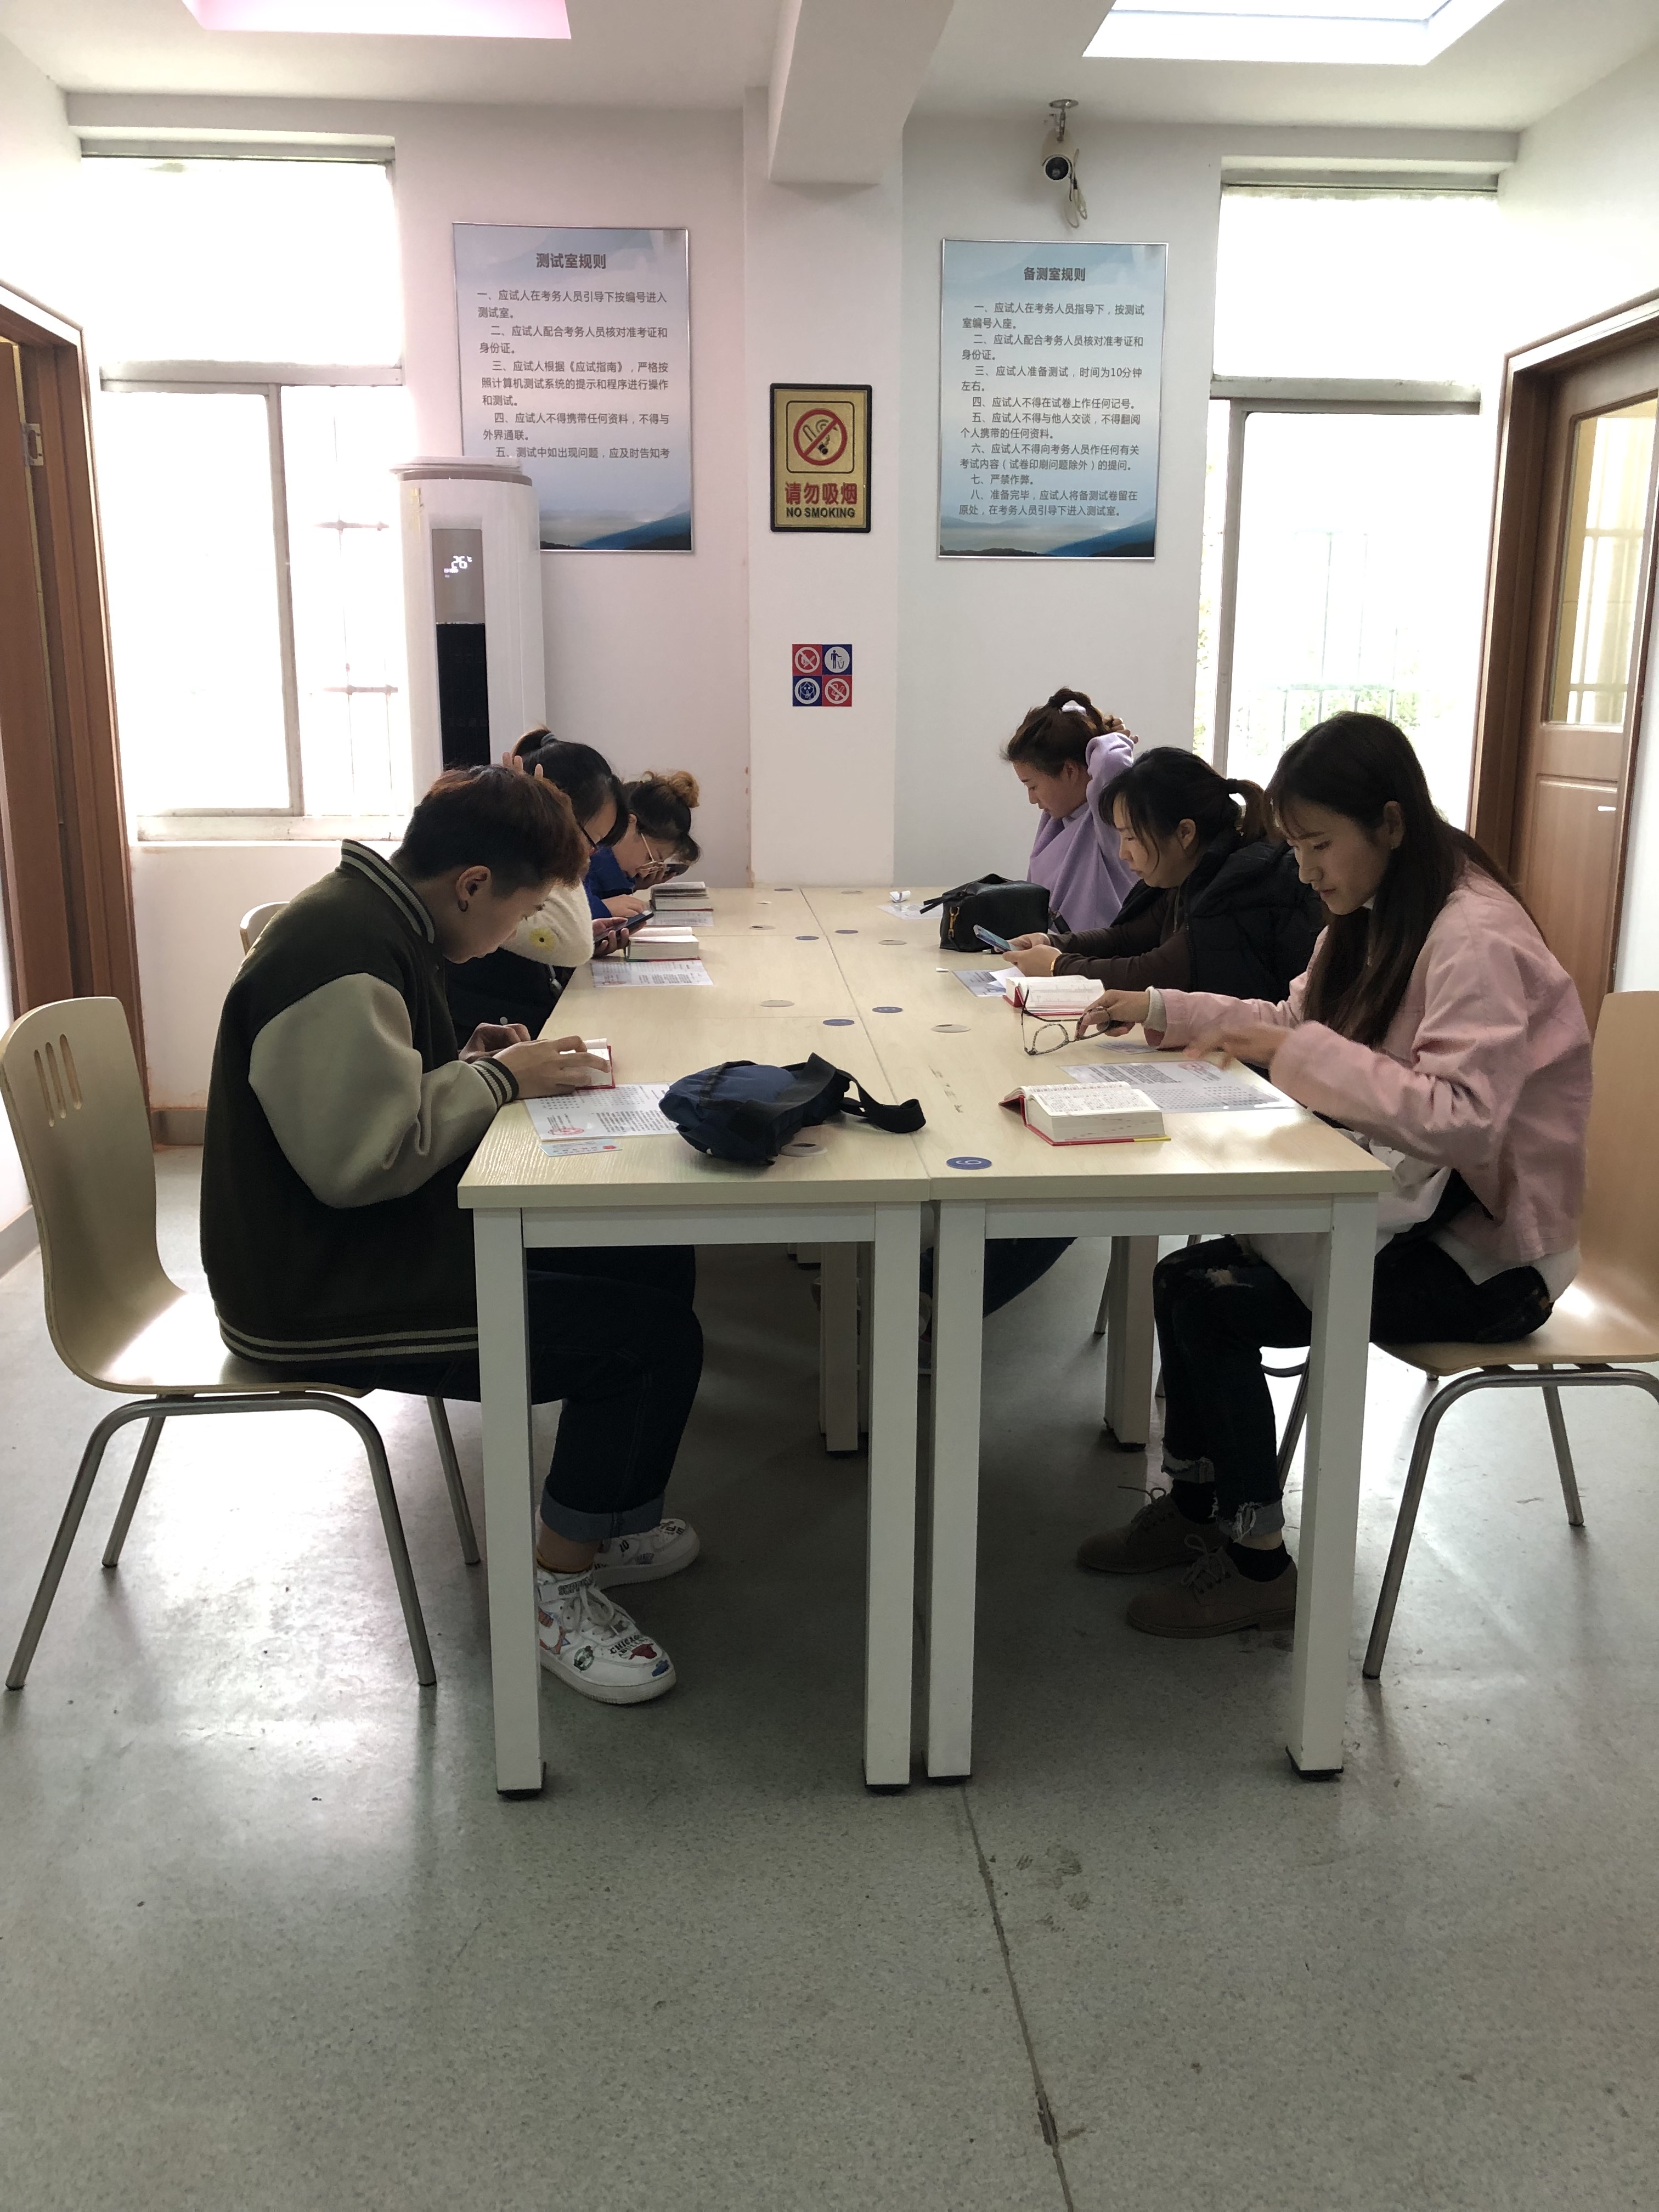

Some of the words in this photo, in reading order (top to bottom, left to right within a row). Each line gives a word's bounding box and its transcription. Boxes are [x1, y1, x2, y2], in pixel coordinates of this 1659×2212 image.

[536, 253, 606, 269] 测试室规则
[1024, 267, 1086, 281] 备测室规则
[478, 307, 514, 319] 测试室。
[962, 318, 1016, 329] 室编号入座。
[479, 342, 515, 354] 身份证。
[962, 349, 995, 360] 身份证。
[961, 381, 985, 392] 左右。
[482, 395, 517, 407] 和测试。
[785, 482, 857, 505] 请勿吸烟
[786, 507, 802, 517] NO
[804, 507, 855, 518] SMOKING
